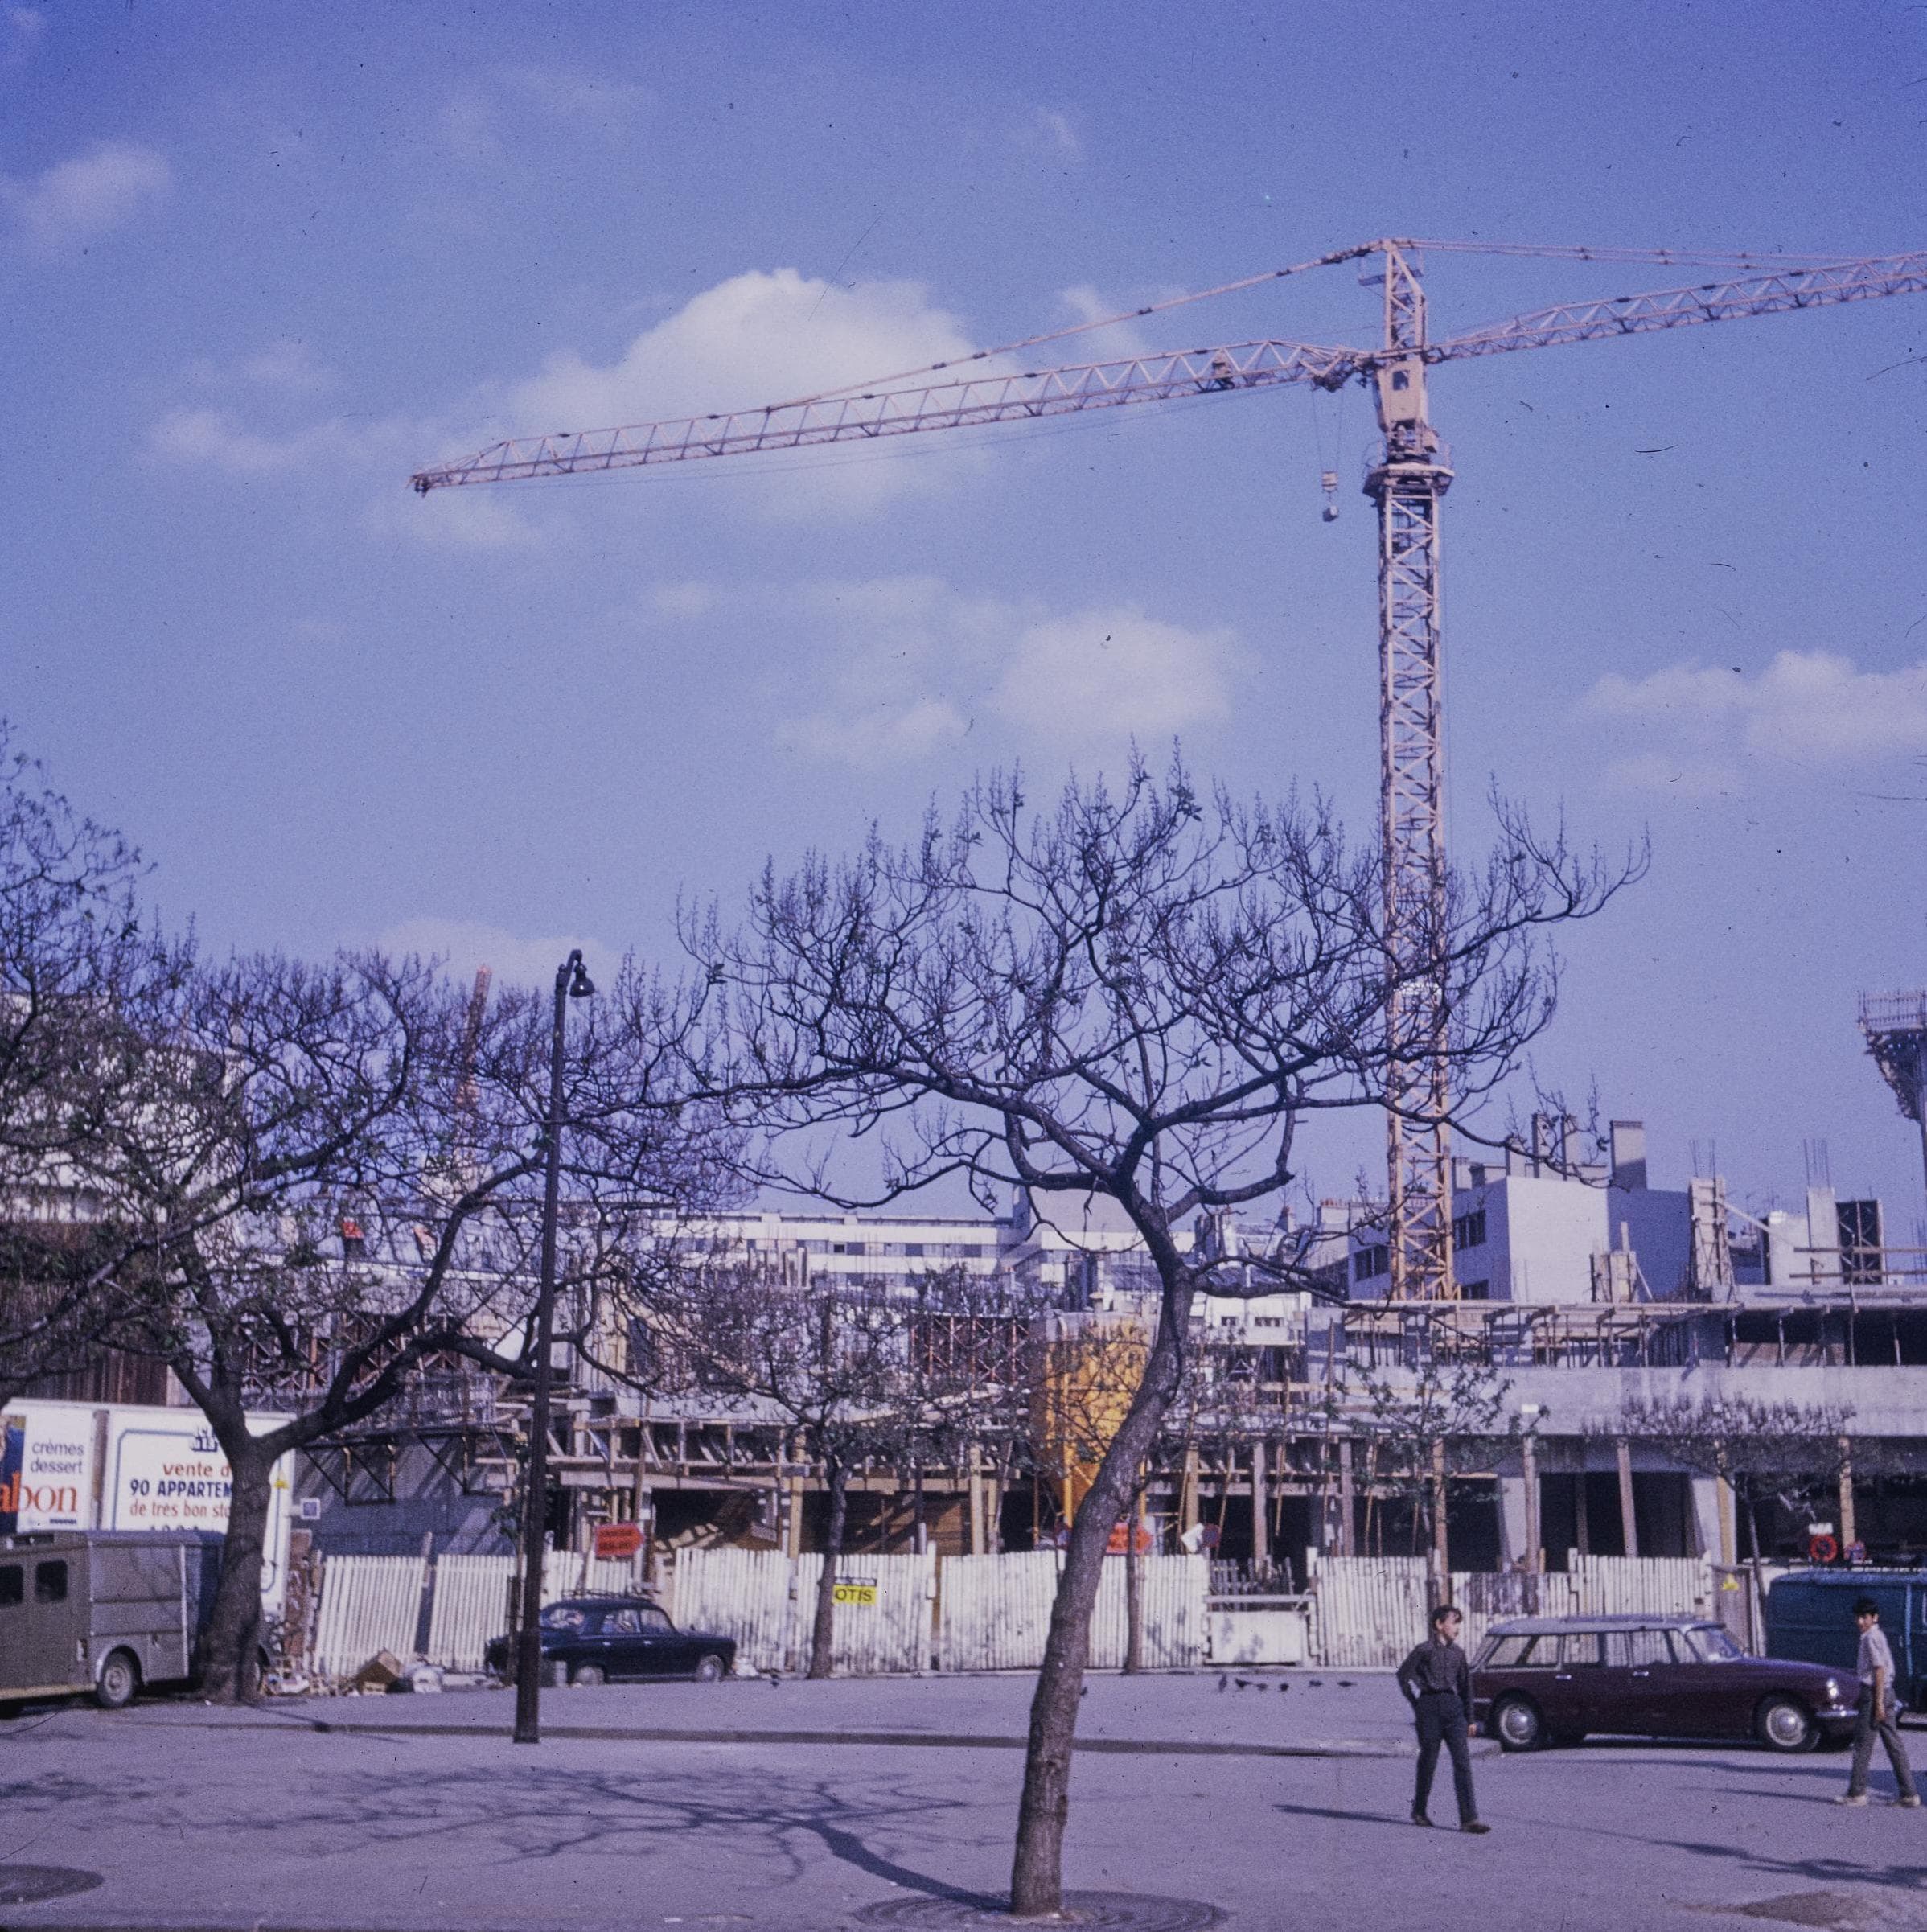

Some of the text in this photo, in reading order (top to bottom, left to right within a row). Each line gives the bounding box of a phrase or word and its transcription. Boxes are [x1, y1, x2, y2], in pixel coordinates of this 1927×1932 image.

[31, 1438, 84, 1457] crèmes
[30, 1457, 83, 1474] dessert
[162, 1461, 213, 1477] vente
[130, 1478, 150, 1496] 90
[129, 1498, 146, 1516] de
[183, 1499, 208, 1518] bon
[835, 1589, 873, 1601] OTIS
